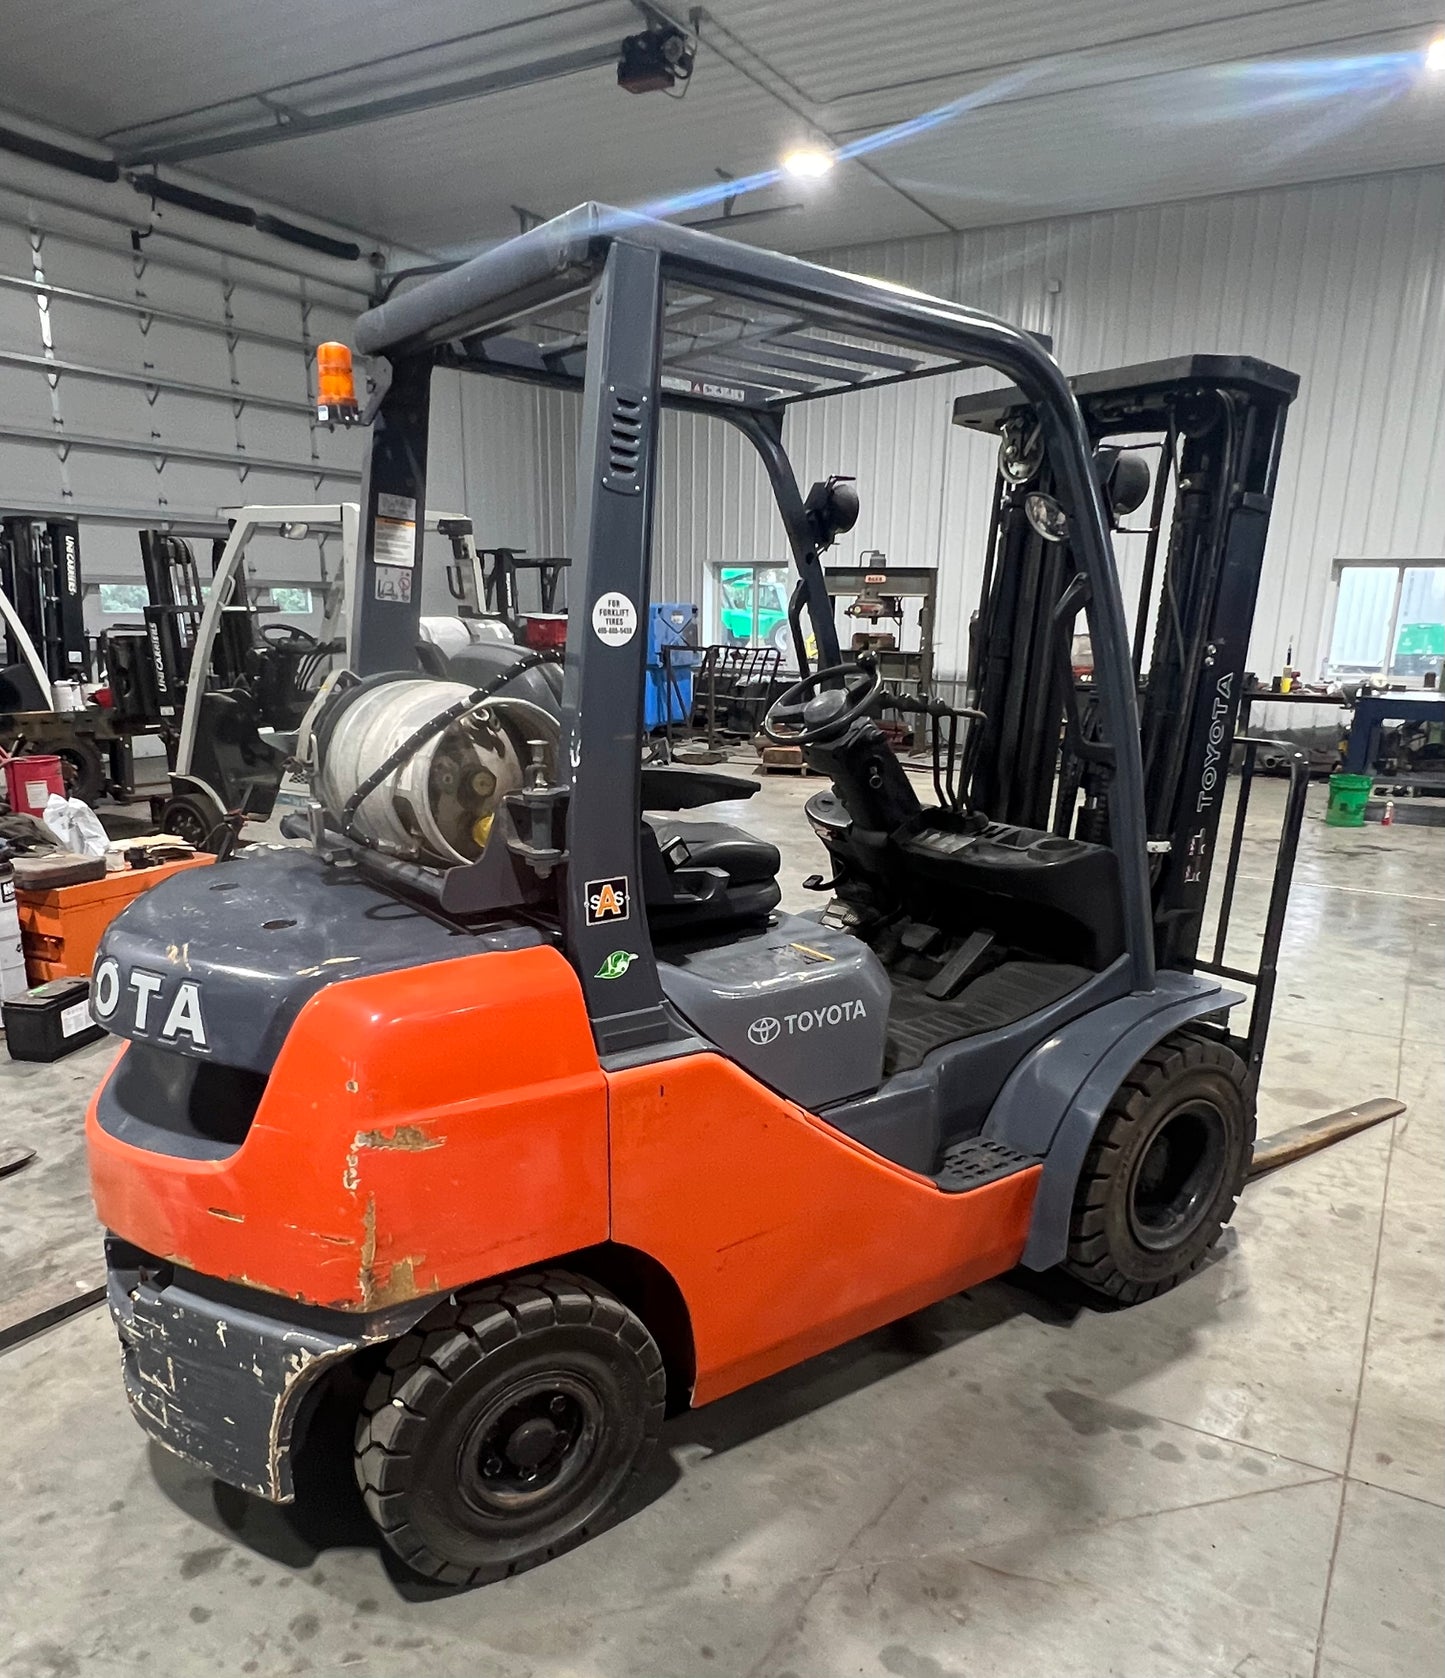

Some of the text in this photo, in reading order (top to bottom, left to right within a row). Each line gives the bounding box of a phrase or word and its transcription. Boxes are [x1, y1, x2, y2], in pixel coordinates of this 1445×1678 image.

[599, 609, 629, 617] FORKLIFT
[1196, 671, 1234, 813] TOYOTA
[784, 999, 867, 1035] TOYOTA
